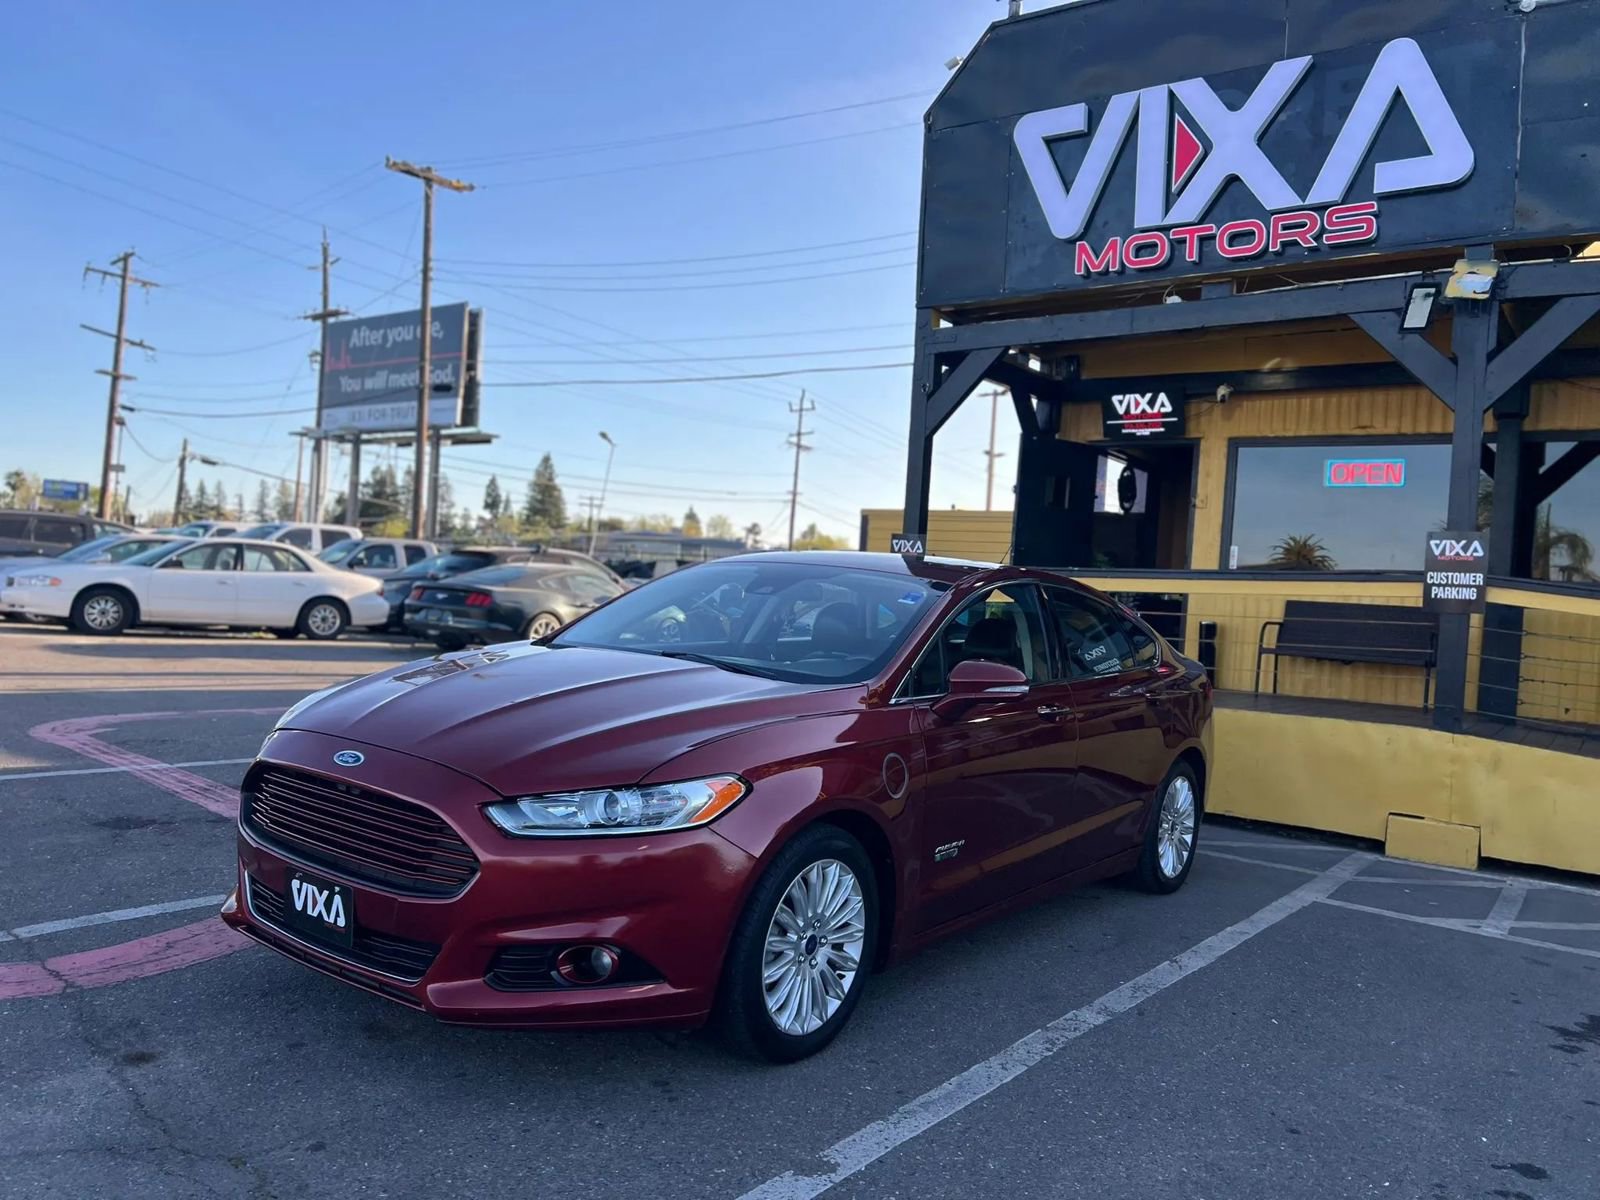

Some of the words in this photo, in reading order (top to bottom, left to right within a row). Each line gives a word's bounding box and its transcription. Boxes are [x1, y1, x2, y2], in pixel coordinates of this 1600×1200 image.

[1013, 37, 1475, 240] VIXA
[1074, 201, 1379, 277] MOTORS
[349, 325, 384, 348] After
[386, 325, 414, 348] you
[339, 376, 361, 393] You
[364, 370, 388, 390] will
[1111, 391, 1173, 415] VIXA
[1330, 462, 1403, 484] OPEN
[892, 539, 923, 554] VIXA
[1429, 539, 1484, 557] VIXA
[1426, 571, 1484, 586] CUSTOMER
[1431, 586, 1477, 600] PARKING
[291, 878, 345, 928] VIXA
